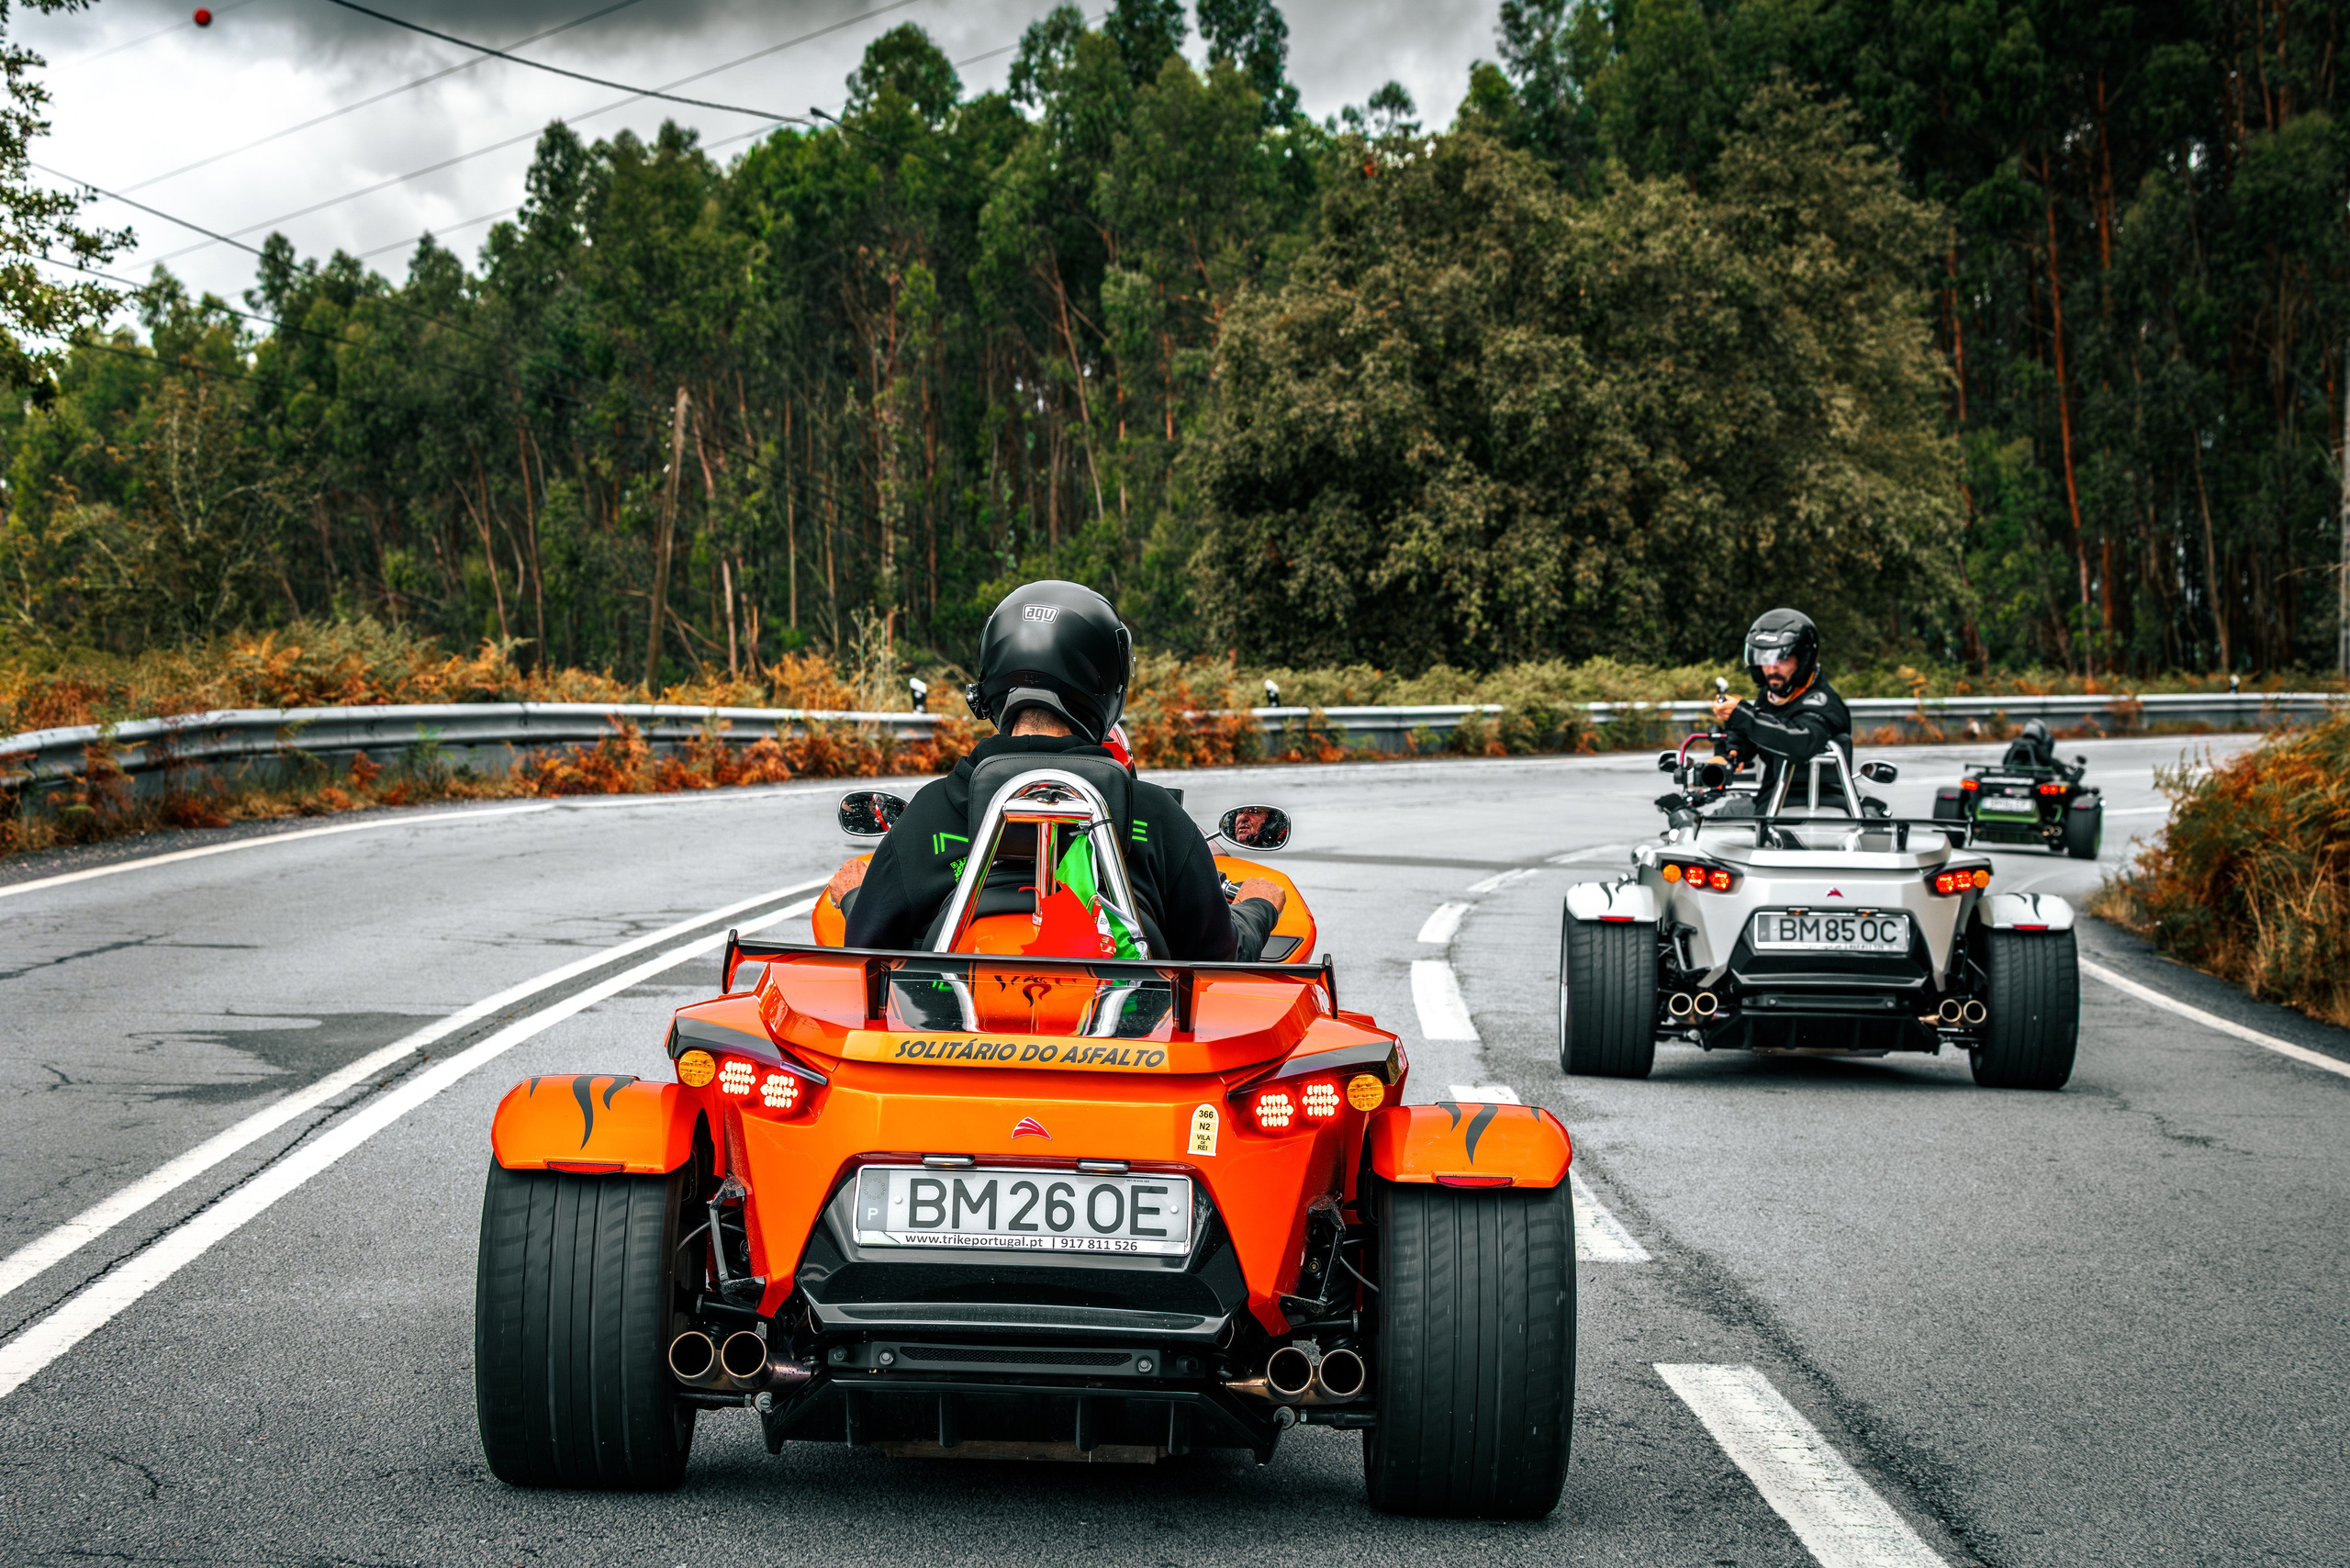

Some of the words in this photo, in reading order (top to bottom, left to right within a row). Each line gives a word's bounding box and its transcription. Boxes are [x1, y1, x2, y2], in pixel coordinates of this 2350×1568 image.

[1025, 607, 1056, 622] agv
[895, 1037, 1016, 1061] SOLITÁRIO
[1019, 1044, 1057, 1063] DO
[1059, 1046, 1166, 1068] ASFALTO
[1198, 1110, 1214, 1118] 366
[1199, 1123, 1211, 1131] N2
[867, 1208, 878, 1221] P
[905, 1233, 1044, 1249] www.trikeportugal.pt
[1060, 1238, 1084, 1249] 917
[1087, 1239, 1111, 1250] 811
[1114, 1240, 1138, 1251] 526
